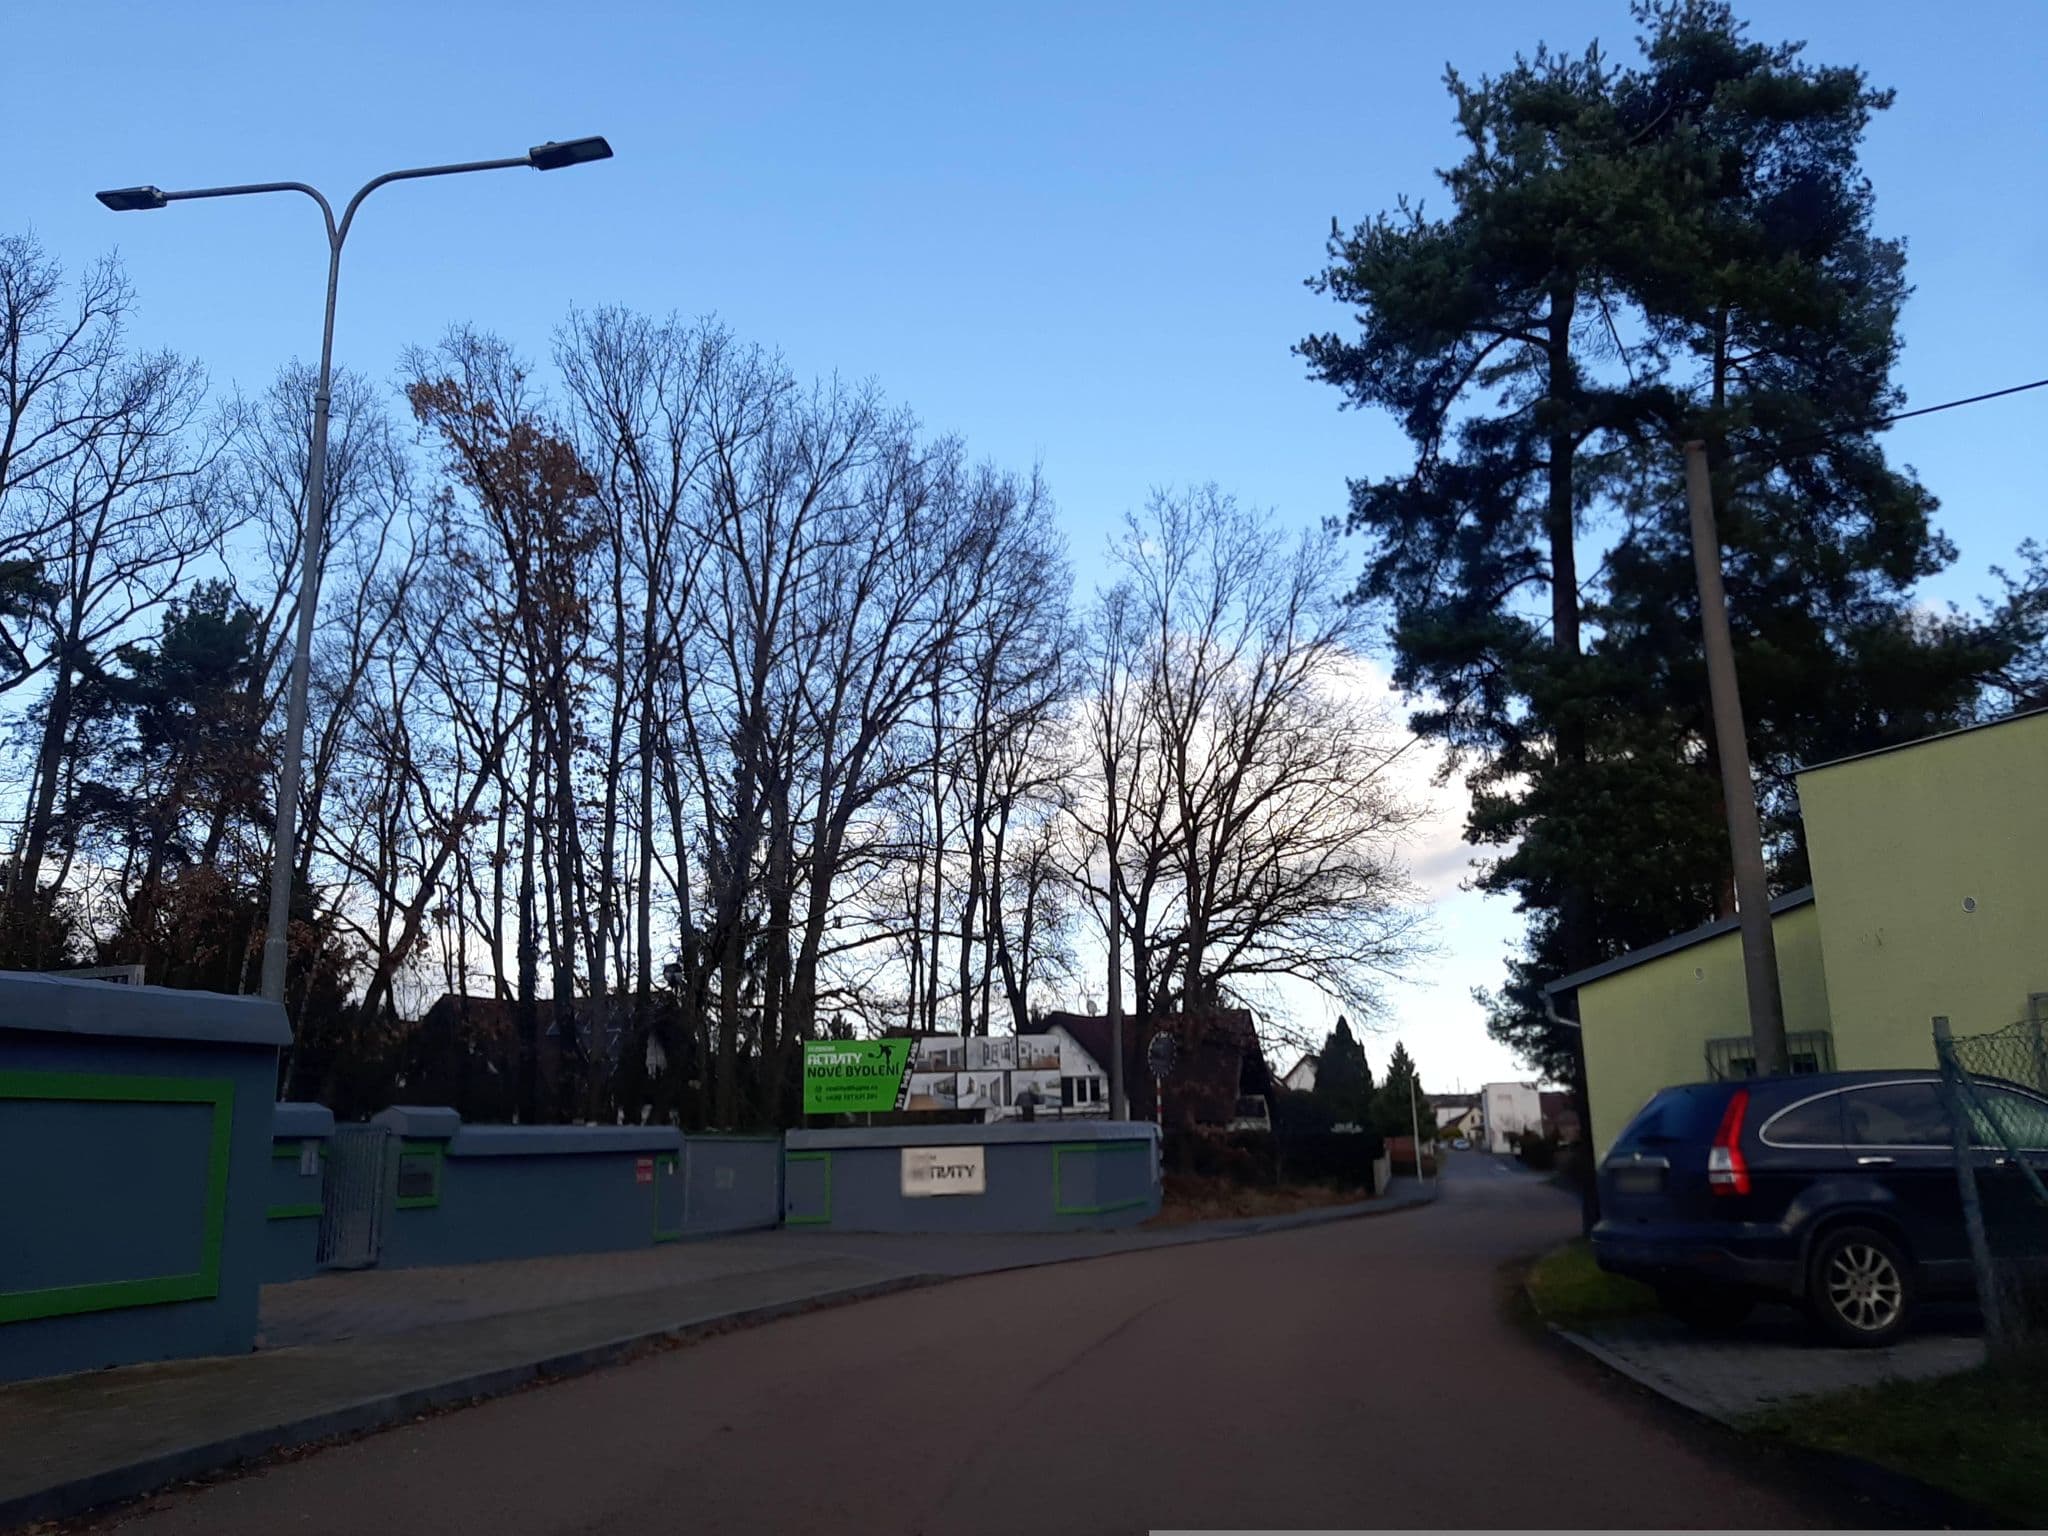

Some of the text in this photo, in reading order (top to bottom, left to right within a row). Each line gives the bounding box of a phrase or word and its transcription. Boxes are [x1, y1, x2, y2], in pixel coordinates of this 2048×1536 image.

[807, 1052, 863, 1066] ACTIVITY
[807, 1062, 900, 1078] NOVÉ BYDLENÍ
[911, 1164, 976, 1181] TIVITY
